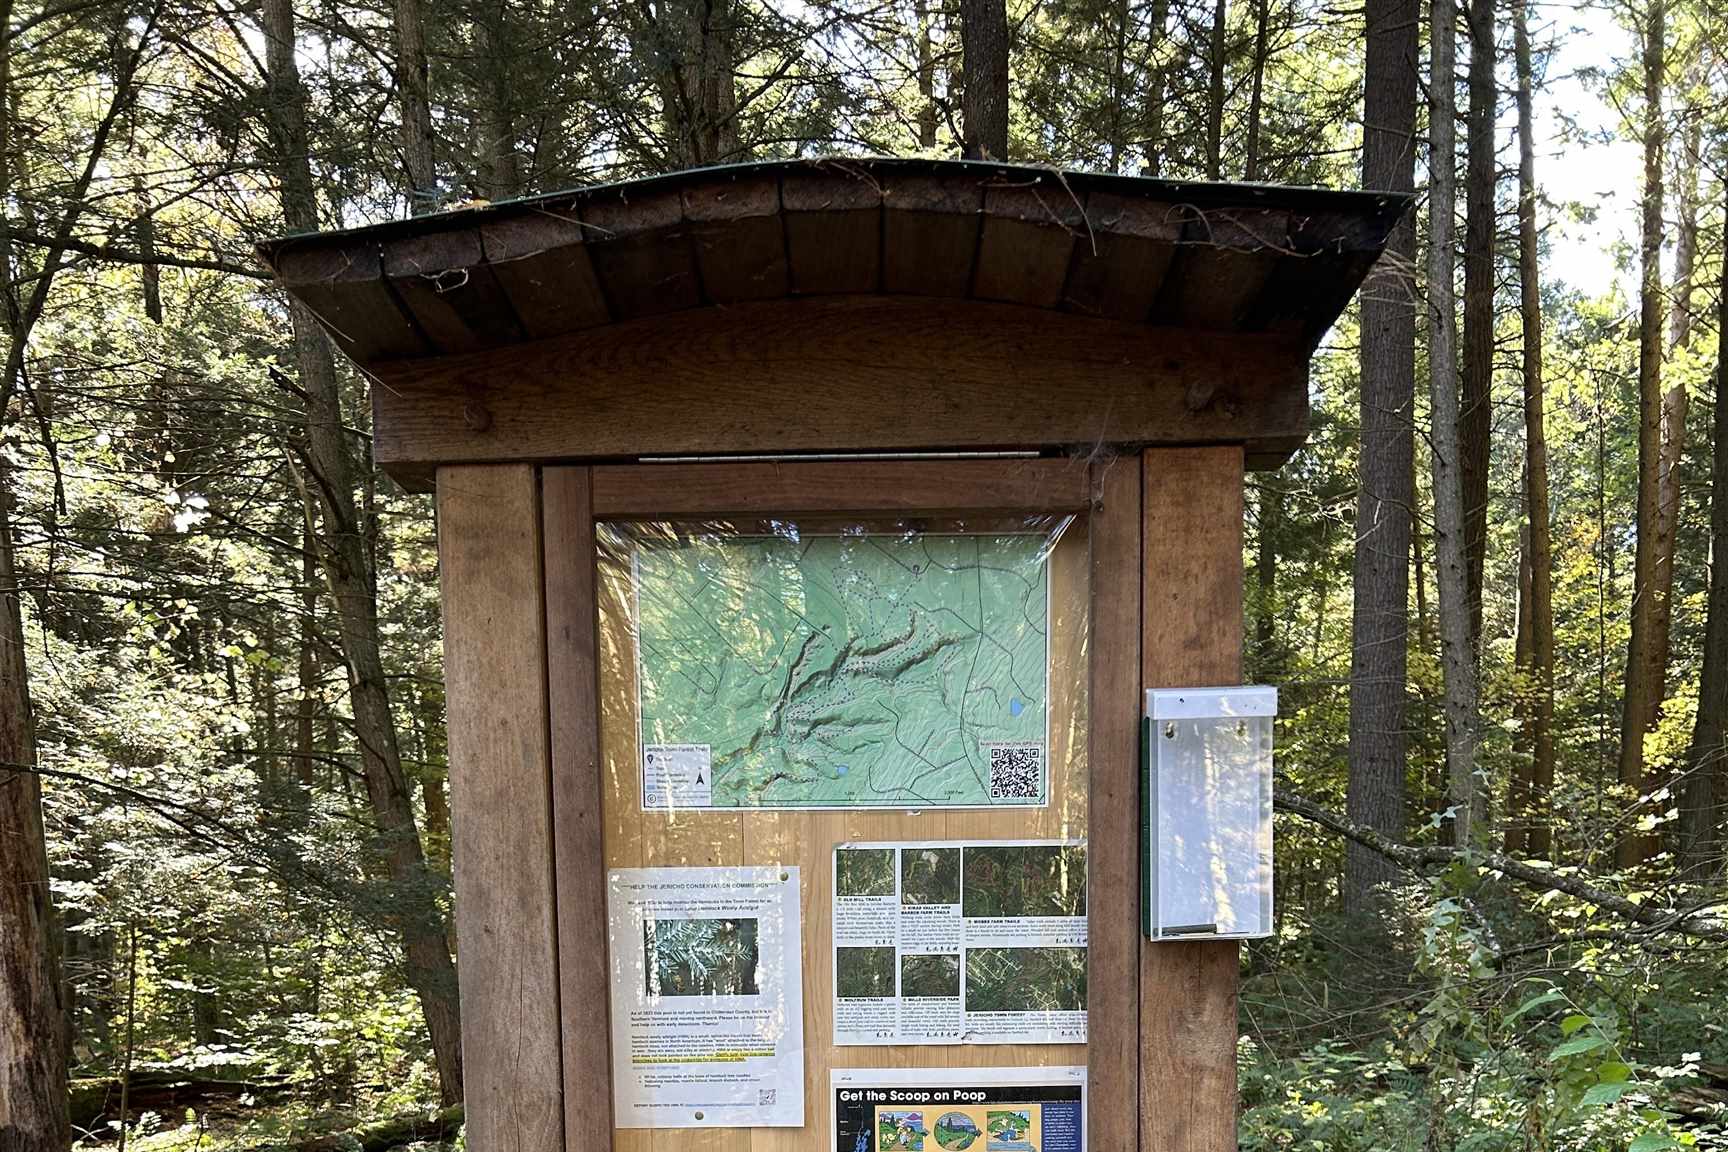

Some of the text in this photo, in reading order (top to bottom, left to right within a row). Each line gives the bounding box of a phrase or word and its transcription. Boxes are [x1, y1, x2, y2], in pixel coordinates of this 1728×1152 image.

[840, 1090, 986, 1102] Get the Scoop on Poop
